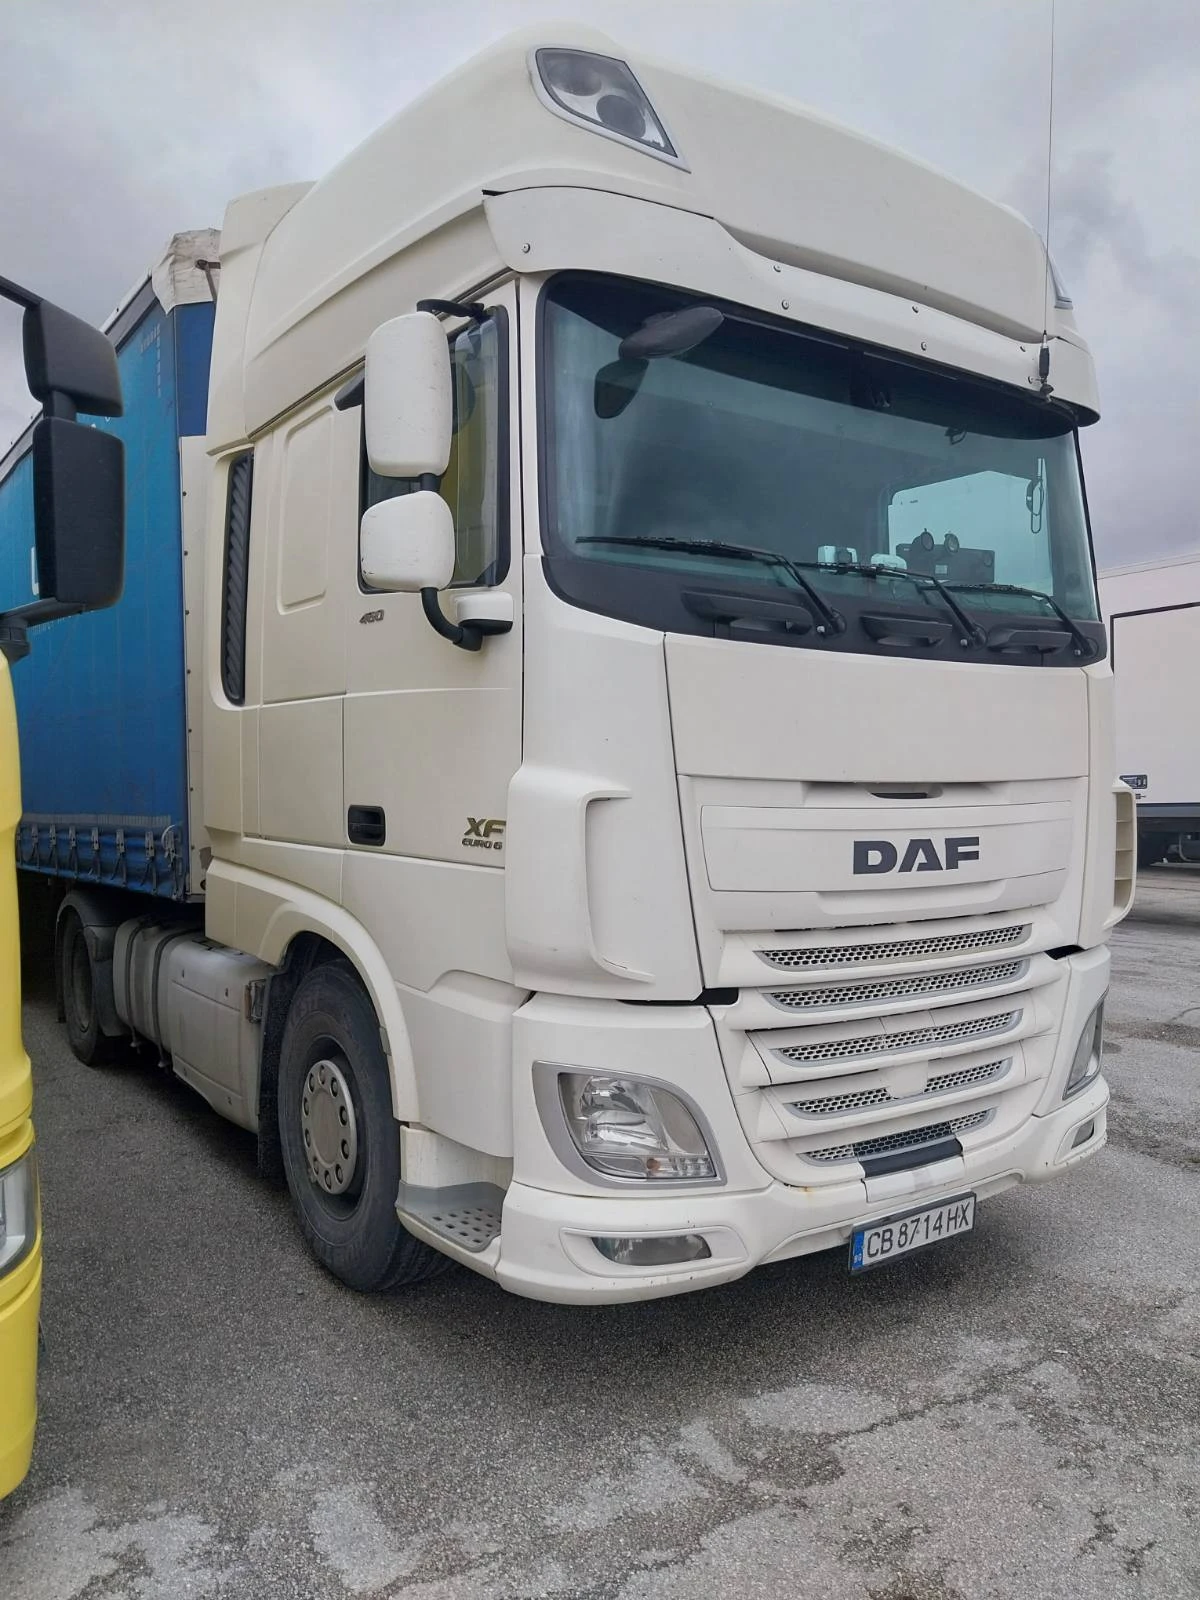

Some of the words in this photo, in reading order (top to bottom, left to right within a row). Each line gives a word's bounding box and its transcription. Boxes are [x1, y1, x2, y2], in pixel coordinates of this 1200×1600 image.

[464, 817, 507, 838] XF
[853, 836, 980, 875] DAF
[867, 1228, 894, 1258] CB
[897, 1211, 943, 1249] 8714
[946, 1202, 971, 1233] HX
